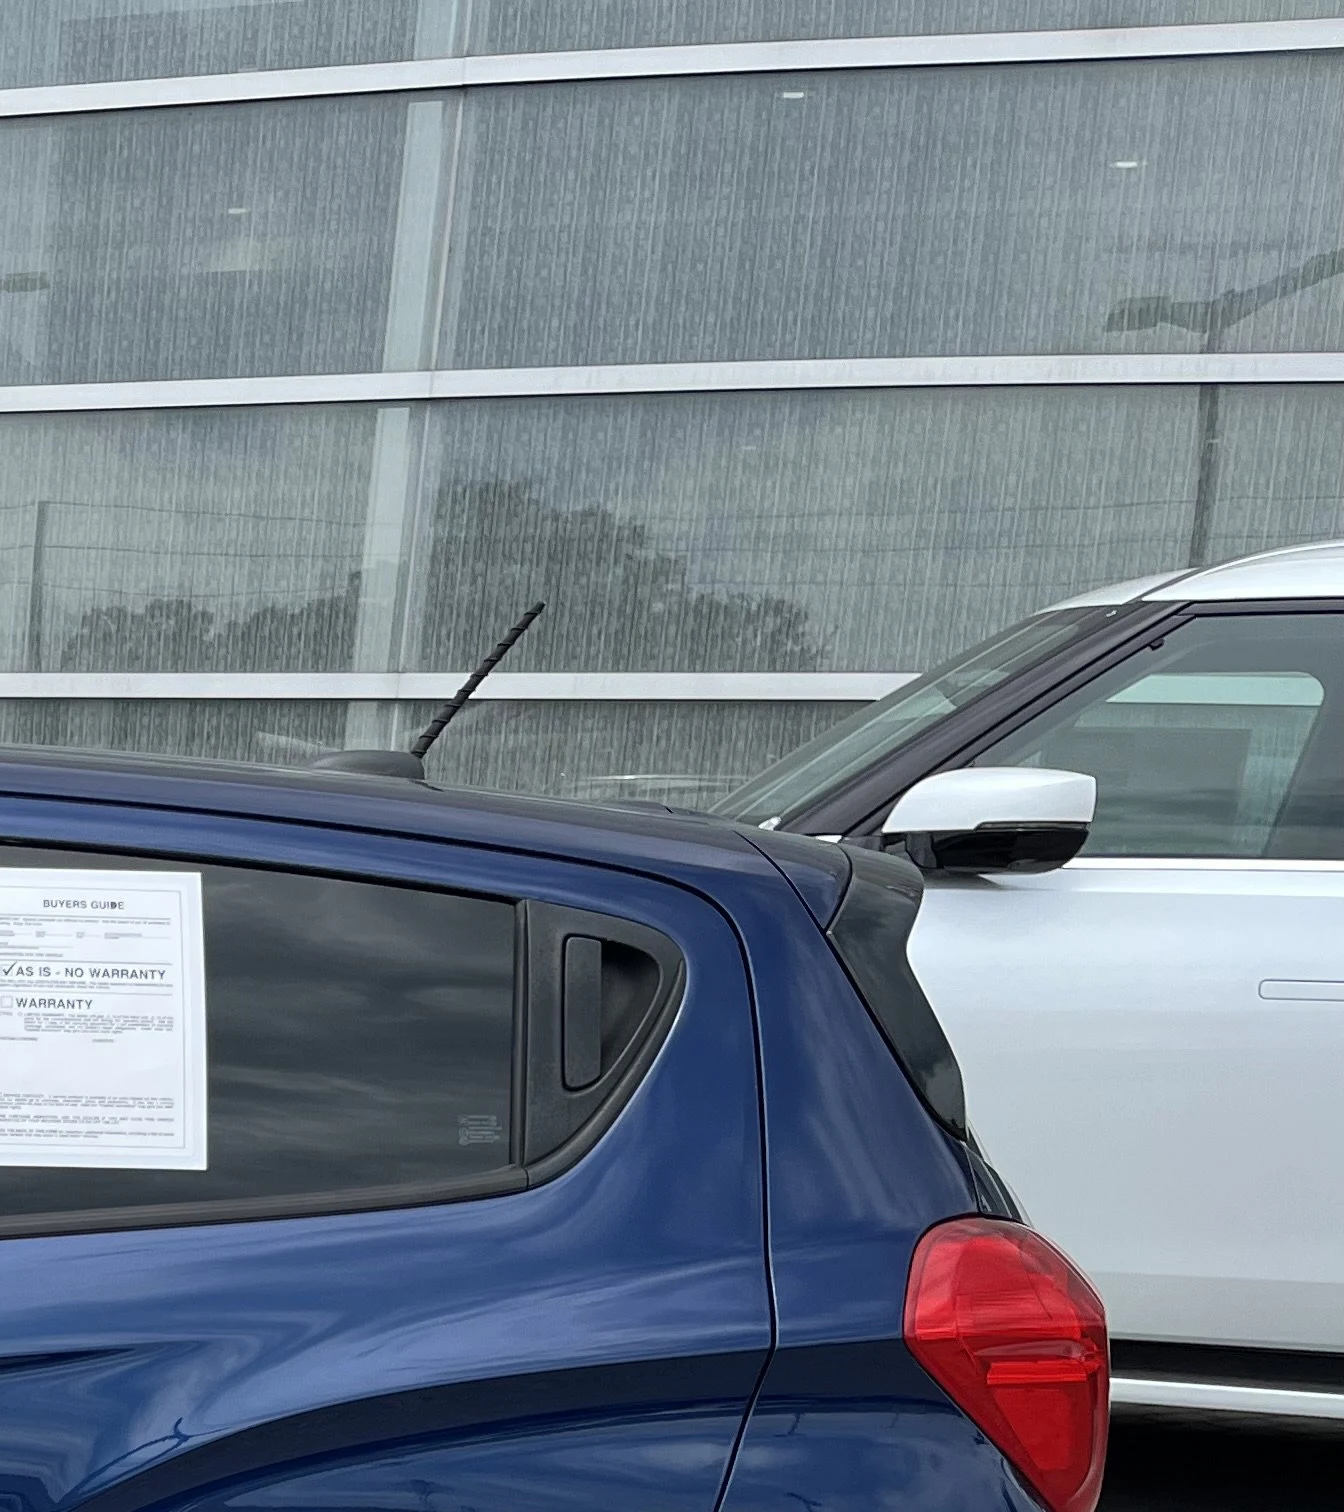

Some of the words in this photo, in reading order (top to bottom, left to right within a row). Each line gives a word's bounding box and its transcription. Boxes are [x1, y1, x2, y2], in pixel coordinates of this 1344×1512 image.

[42, 899, 87, 910] BUYERS
[91, 900, 125, 911] GUIDE
[15, 966, 34, 977] AS
[39, 966, 51, 977] IS
[64, 967, 84, 978] NO
[89, 967, 166, 980] WARRANTY
[15, 997, 93, 1010] WARRANTY
